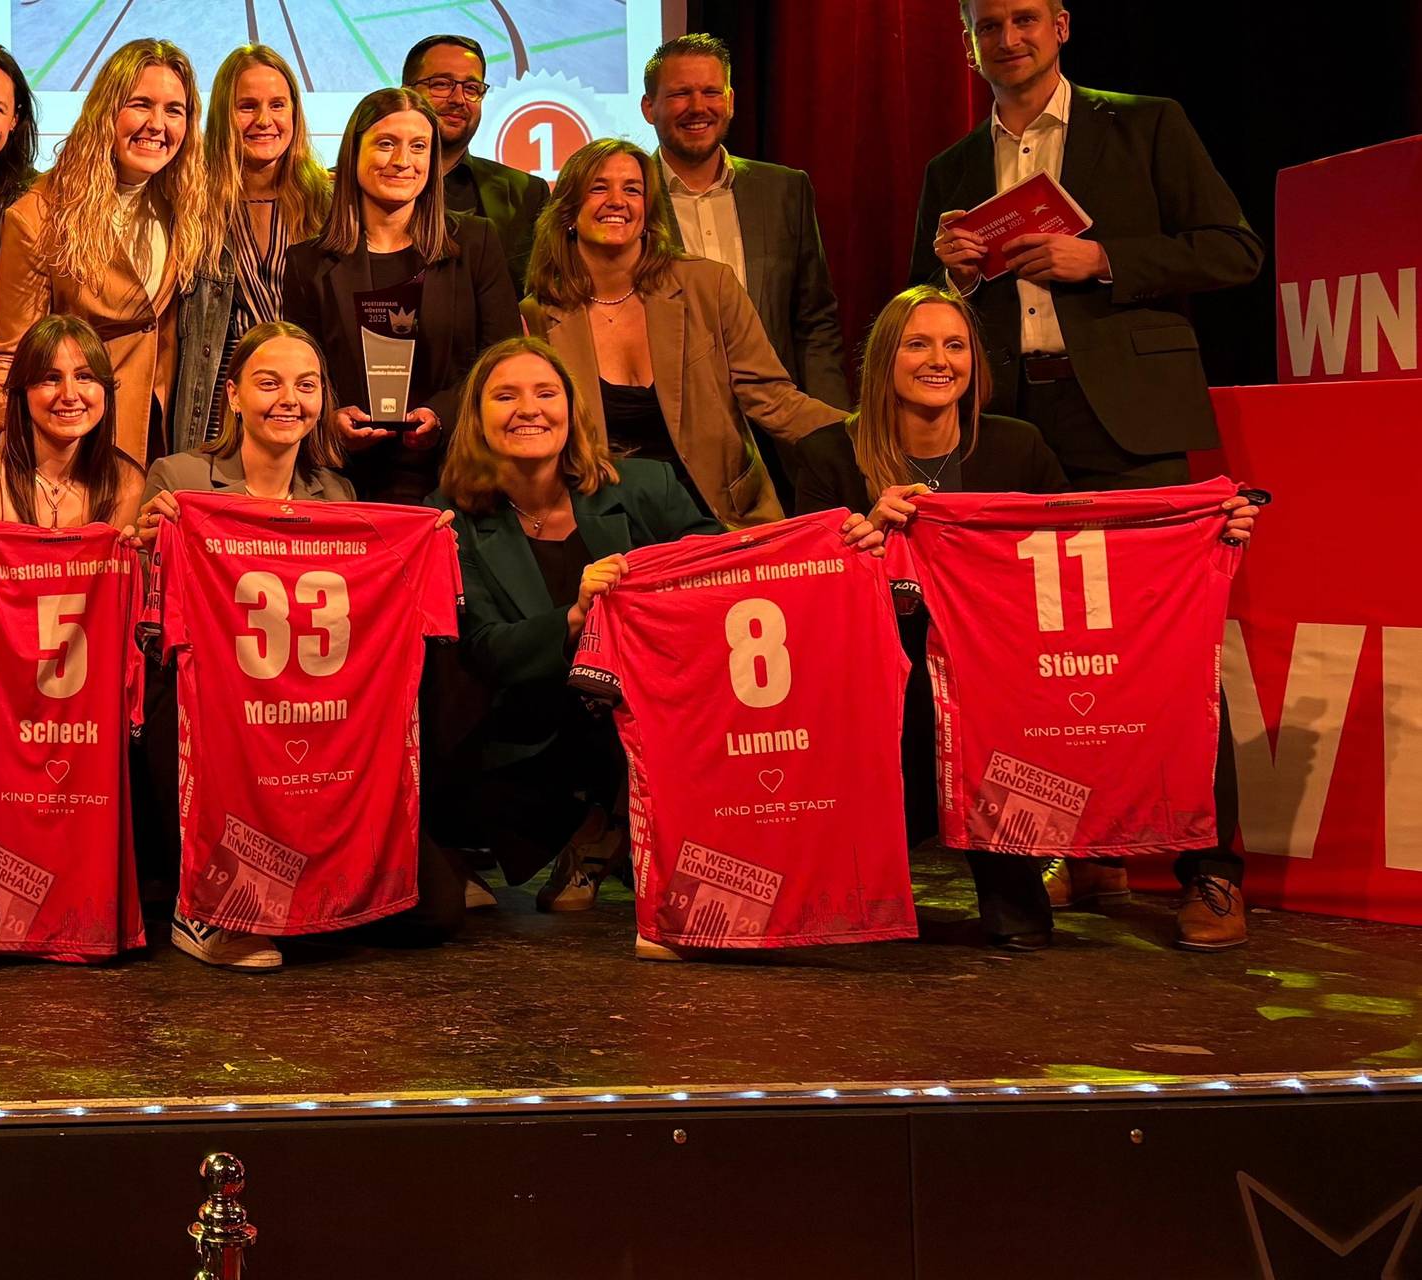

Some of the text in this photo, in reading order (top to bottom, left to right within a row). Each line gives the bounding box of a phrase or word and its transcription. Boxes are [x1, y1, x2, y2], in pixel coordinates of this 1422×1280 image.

[529, 122, 560, 181] 1
[974, 210, 1020, 236] ORTLERWAHL
[368, 315, 387, 323] 2025
[1280, 267, 1417, 377] WN
[205, 539, 367, 556] SC Westfalia Kinderhaus
[679, 568, 751, 589] Westfalia
[756, 558, 844, 582] Kinderhaus
[1016, 527, 1113, 632] 11
[234, 570, 351, 680] 33
[37, 593, 88, 699] 5
[724, 598, 792, 708] 8
[1038, 652, 1119, 678] Stöver
[244, 699, 347, 725] Meßmann
[19, 719, 98, 744] Scheck
[726, 727, 810, 756] Lumme
[944, 712, 952, 753] LOGISTIK
[1024, 723, 1146, 737] KIND DER STADT
[282, 774, 310, 785] DER
[312, 770, 354, 783] STADT
[990, 768, 1080, 811] KINDERHAUS
[992, 754, 1086, 799] SC WESTFALIA
[1, 792, 110, 806] KIND DER STADT
[181, 775, 194, 818] LOGISTIK
[714, 799, 836, 817] KIND DER STADT
[977, 798, 999, 817] 19
[756, 816, 797, 824] MÜNSTER
[226, 818, 304, 871] SC WESTFALIA
[1046, 826, 1068, 843] 20
[227, 838, 297, 883] KINDERHAUS
[639, 850, 651, 898] SPEDITION
[682, 844, 779, 888] SC WESTFALIA
[205, 864, 229, 886] 19
[681, 858, 773, 901] KINDERHAUS
[668, 891, 689, 910] 19
[7, 915, 25, 934] 20
[738, 917, 760, 934] 20
